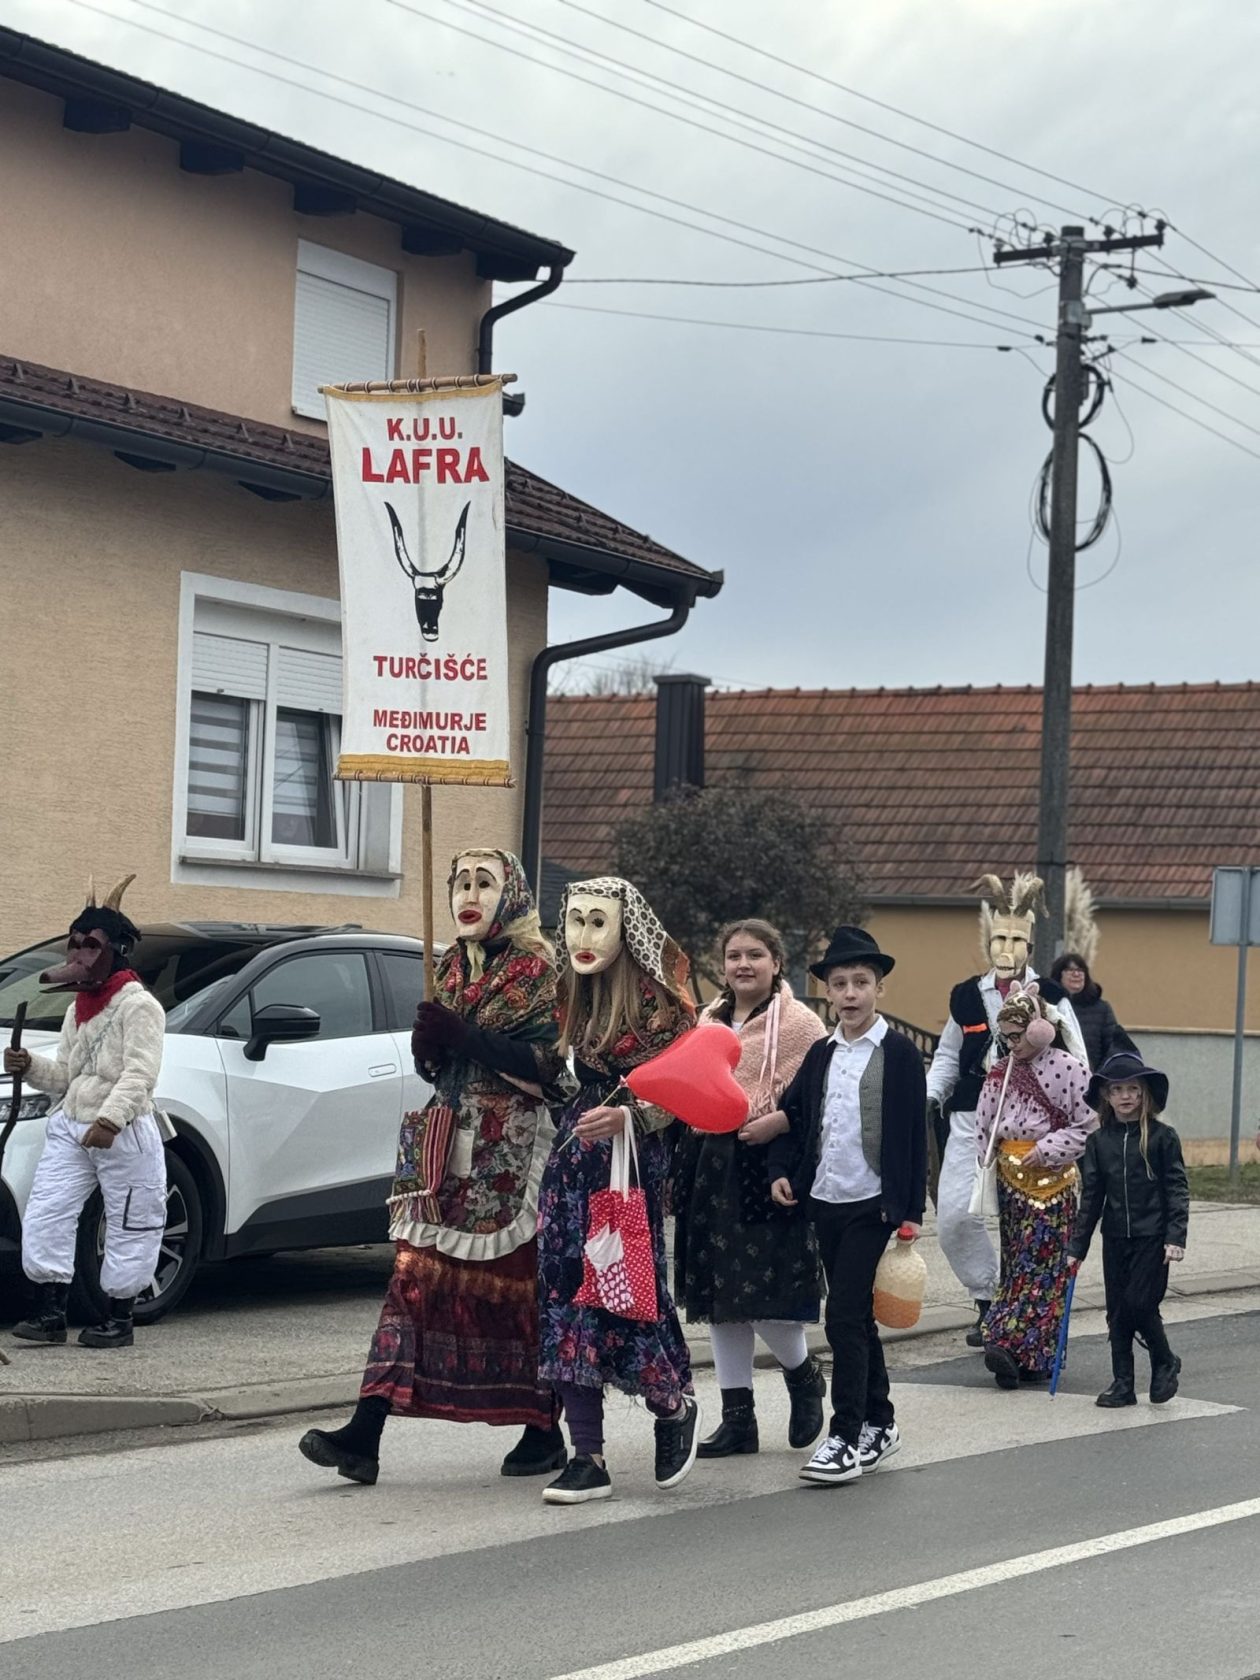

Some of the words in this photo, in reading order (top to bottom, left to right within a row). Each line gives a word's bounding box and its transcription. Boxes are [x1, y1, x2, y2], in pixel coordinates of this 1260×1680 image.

[386, 417, 463, 442] K.U.U.
[361, 446, 490, 485] LAFRA
[373, 652, 488, 681] TURČIŠĆE
[373, 709, 487, 731] MEĐIMURJE
[386, 733, 470, 755] CROATIA
